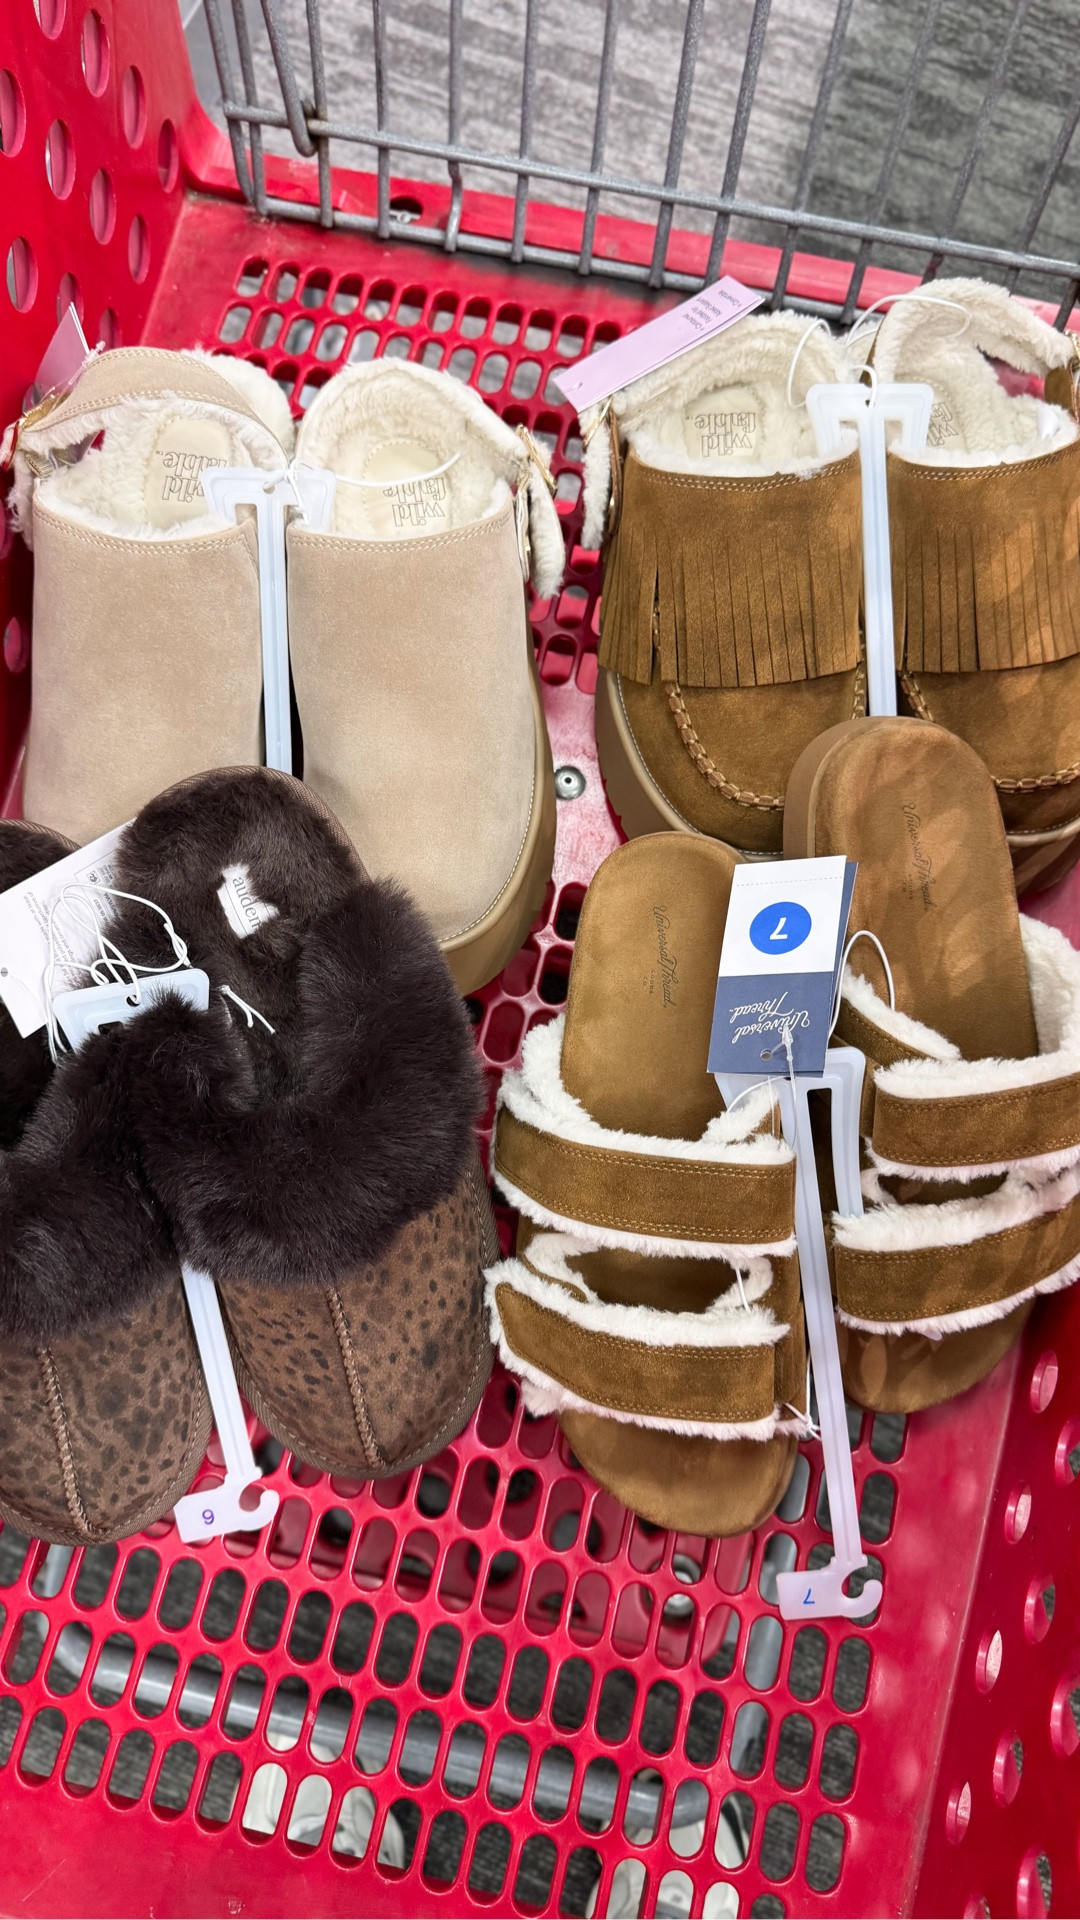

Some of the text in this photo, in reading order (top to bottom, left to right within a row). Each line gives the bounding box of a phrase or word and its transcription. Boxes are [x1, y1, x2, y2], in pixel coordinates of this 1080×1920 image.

[702, 434, 752, 457] wild
[391, 502, 445, 527] wild
[232, 876, 262, 928] auden
[769, 917, 789, 940] 7
[652, 905, 679, 1007] Universal Thread
[732, 1010, 810, 1045] Universal
[201, 1509, 215, 1525] 6
[803, 1588, 815, 1605] 7
